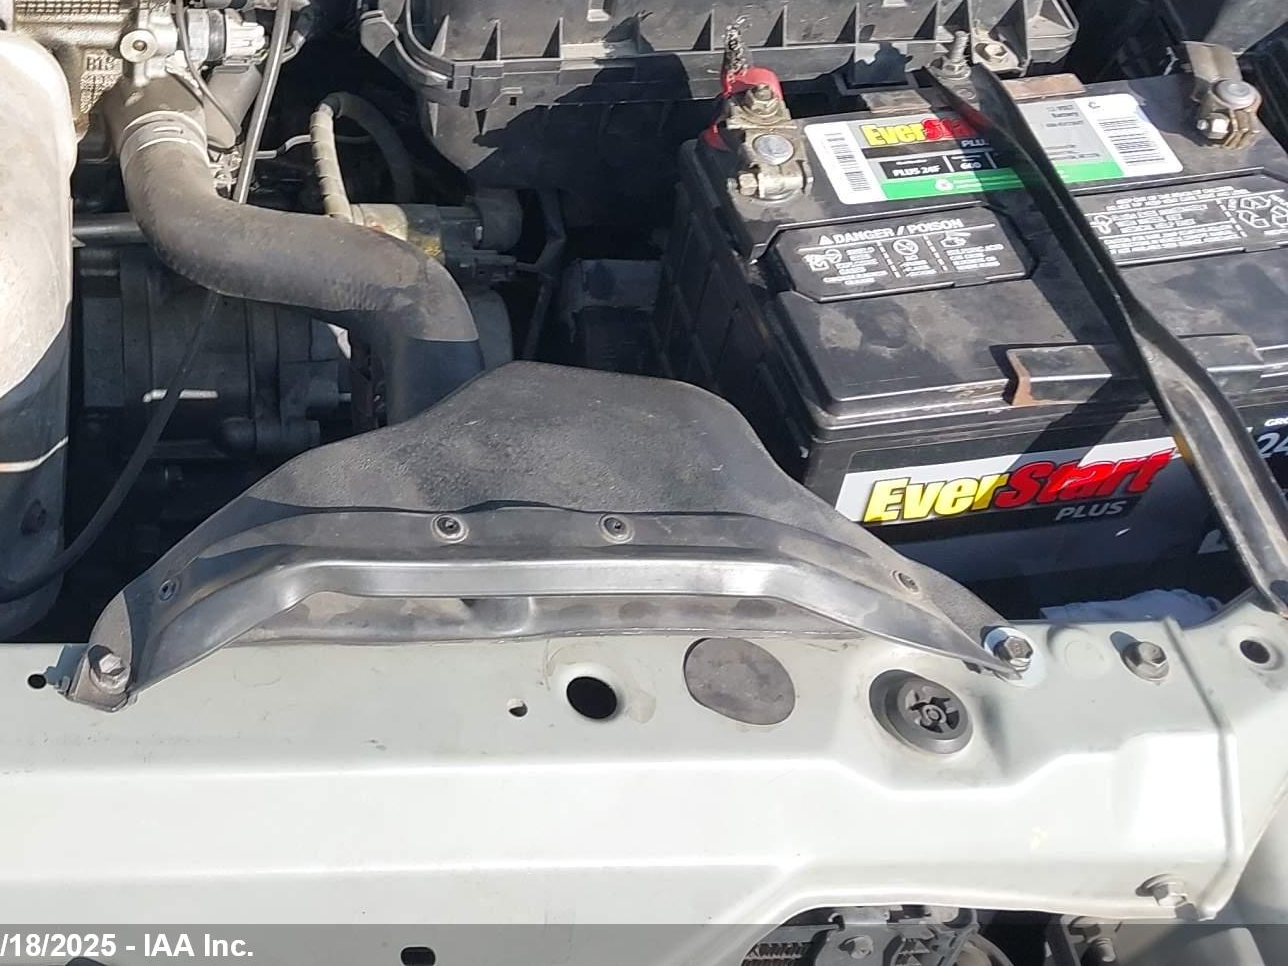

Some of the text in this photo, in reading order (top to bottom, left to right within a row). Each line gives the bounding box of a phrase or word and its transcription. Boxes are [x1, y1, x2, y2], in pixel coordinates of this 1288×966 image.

[962, 138, 990, 148] PLU
[832, 227, 895, 244] DANGER
[906, 218, 965, 234] POISON
[863, 448, 1176, 525] EverStart
[1055, 500, 1129, 522] PLUS
